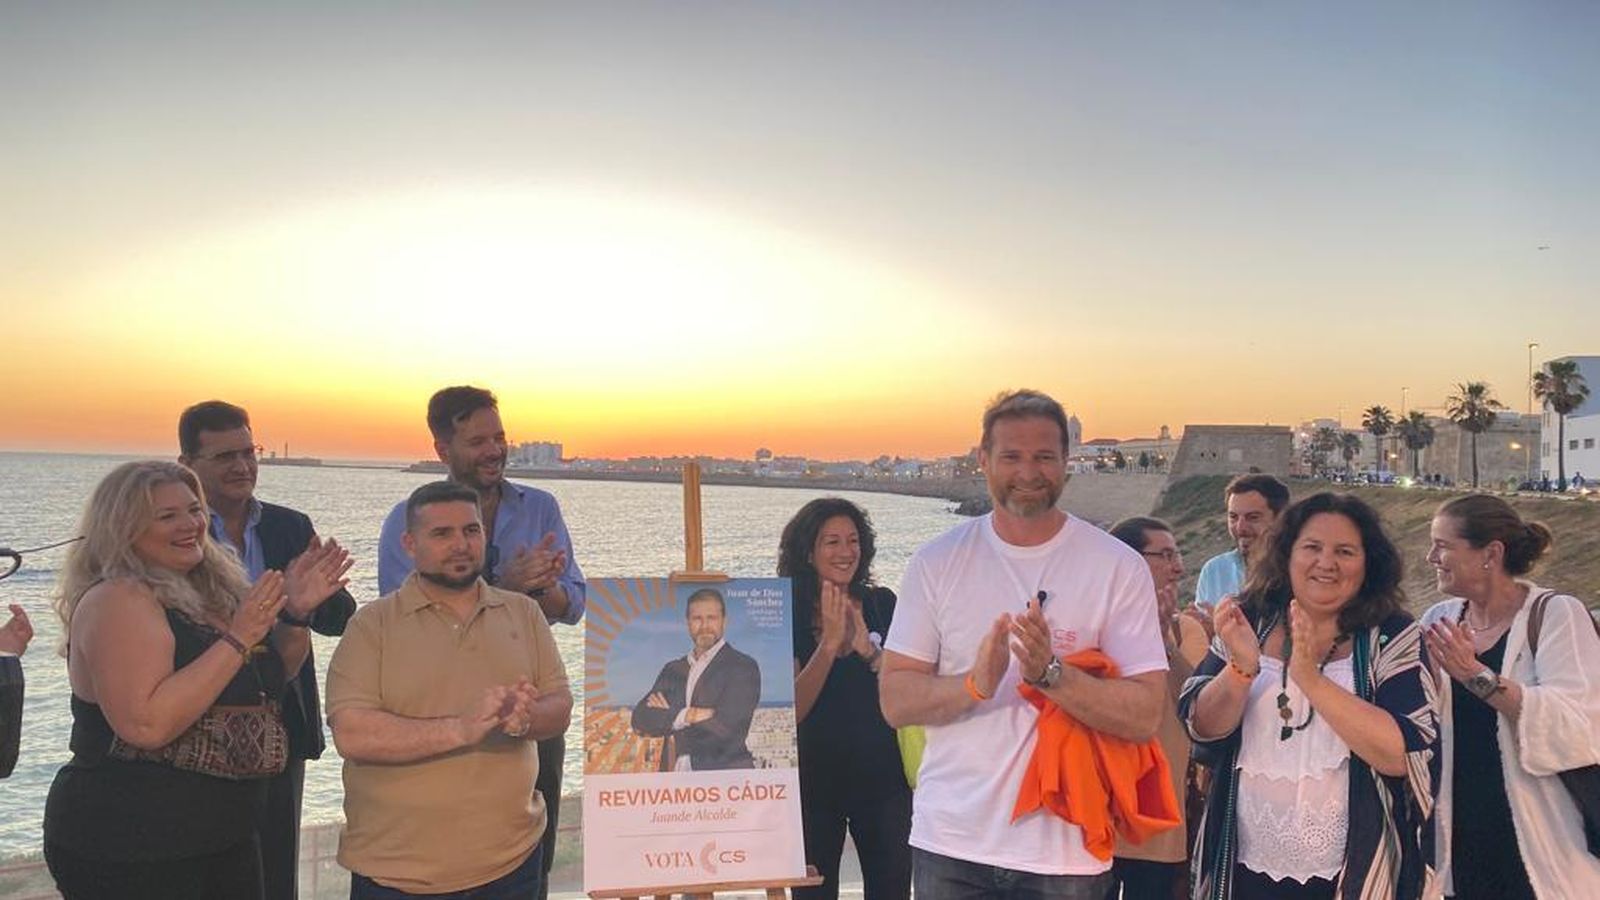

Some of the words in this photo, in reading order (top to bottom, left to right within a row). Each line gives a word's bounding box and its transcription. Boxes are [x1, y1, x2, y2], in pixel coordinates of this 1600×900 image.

[1053, 629, 1077, 641] CS
[599, 786, 721, 807] REVIVAMOS
[727, 780, 787, 801] CÁDIZ
[651, 809, 693, 824] Juande
[695, 807, 737, 822] Alcalde
[643, 851, 694, 869] VOTA
[719, 850, 746, 863] CS
